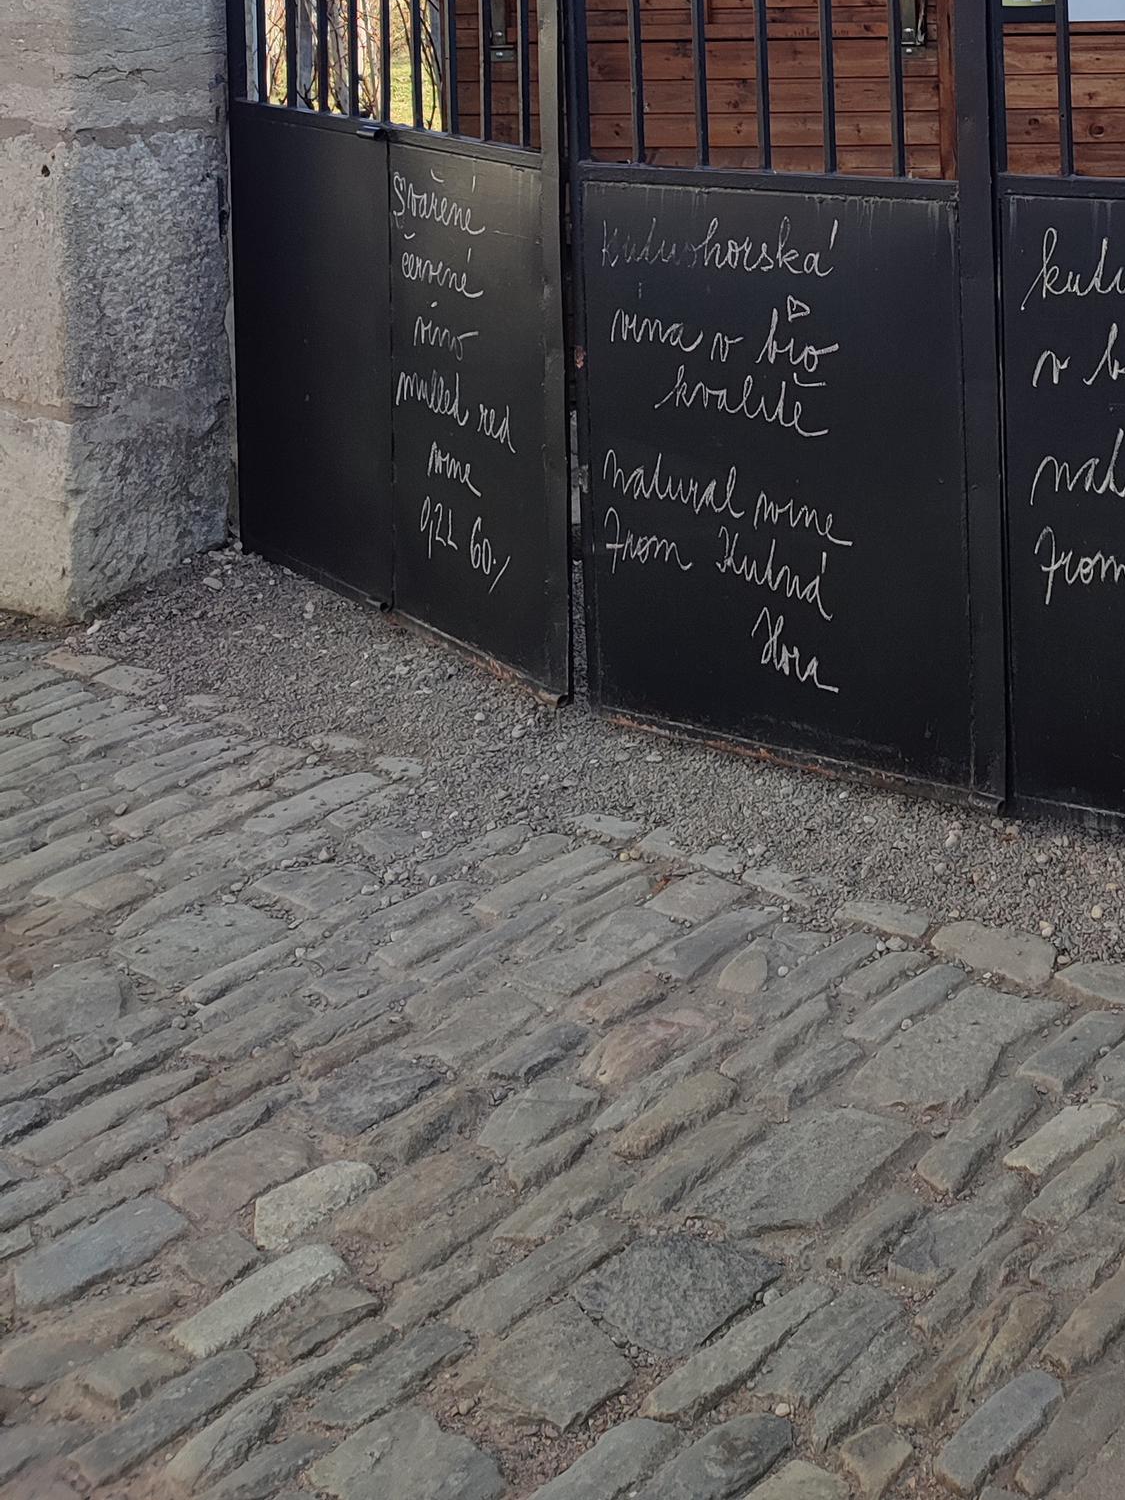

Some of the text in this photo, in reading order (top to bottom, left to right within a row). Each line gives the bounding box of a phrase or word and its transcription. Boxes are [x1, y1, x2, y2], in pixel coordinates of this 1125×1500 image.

[711, 331, 744, 362] v
[1032, 349, 1071, 388] v
[395, 369, 516, 453] mulled red
[603, 449, 745, 519] natural
